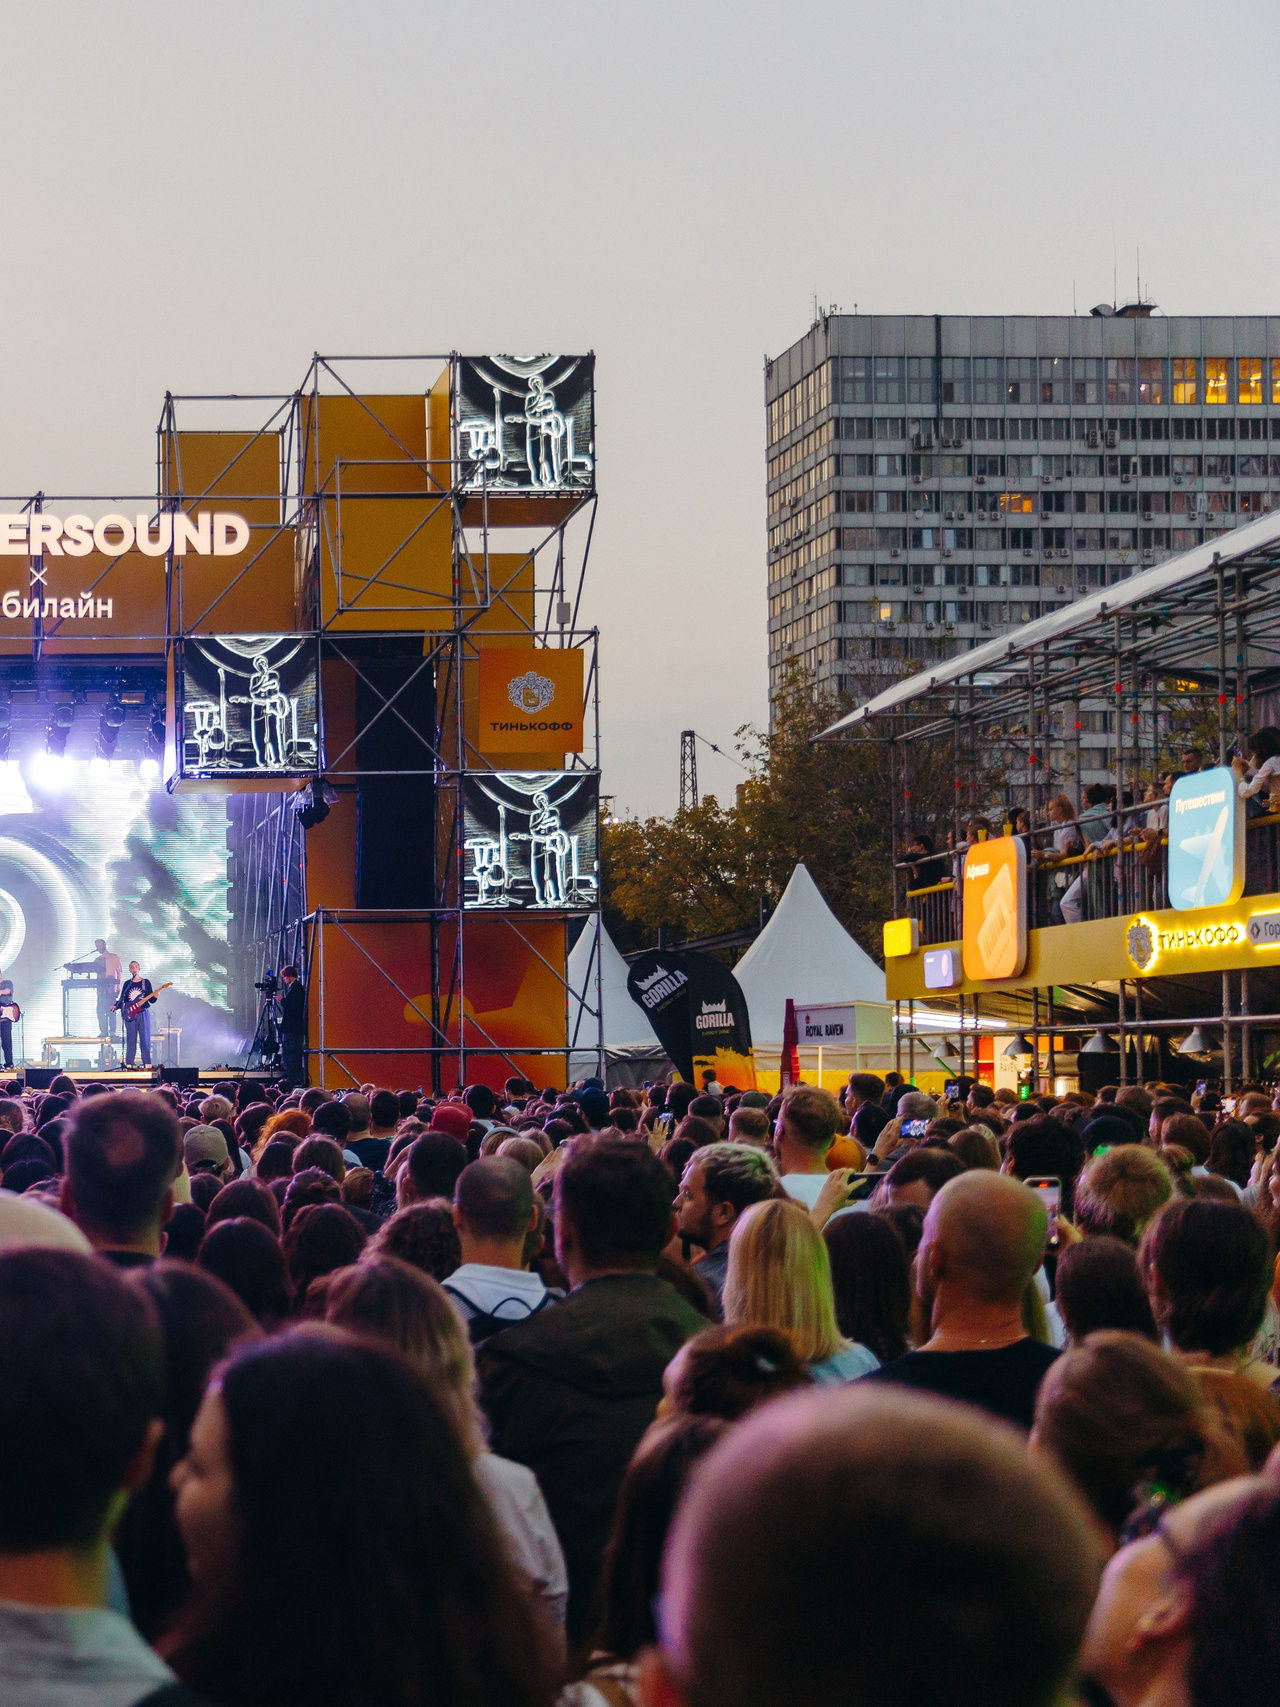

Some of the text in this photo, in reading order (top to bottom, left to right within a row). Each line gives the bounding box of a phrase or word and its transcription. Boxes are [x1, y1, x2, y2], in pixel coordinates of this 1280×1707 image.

[2, 590, 113, 619] билайн
[490, 722, 573, 731] ТИНЬКОФФ
[1159, 926, 1239, 949] ТИНЬКОФФ
[641, 969, 689, 1009] GORILLA
[695, 1012, 735, 1029] GORILLA
[805, 1024, 844, 1037] ROYAL RAVEN
